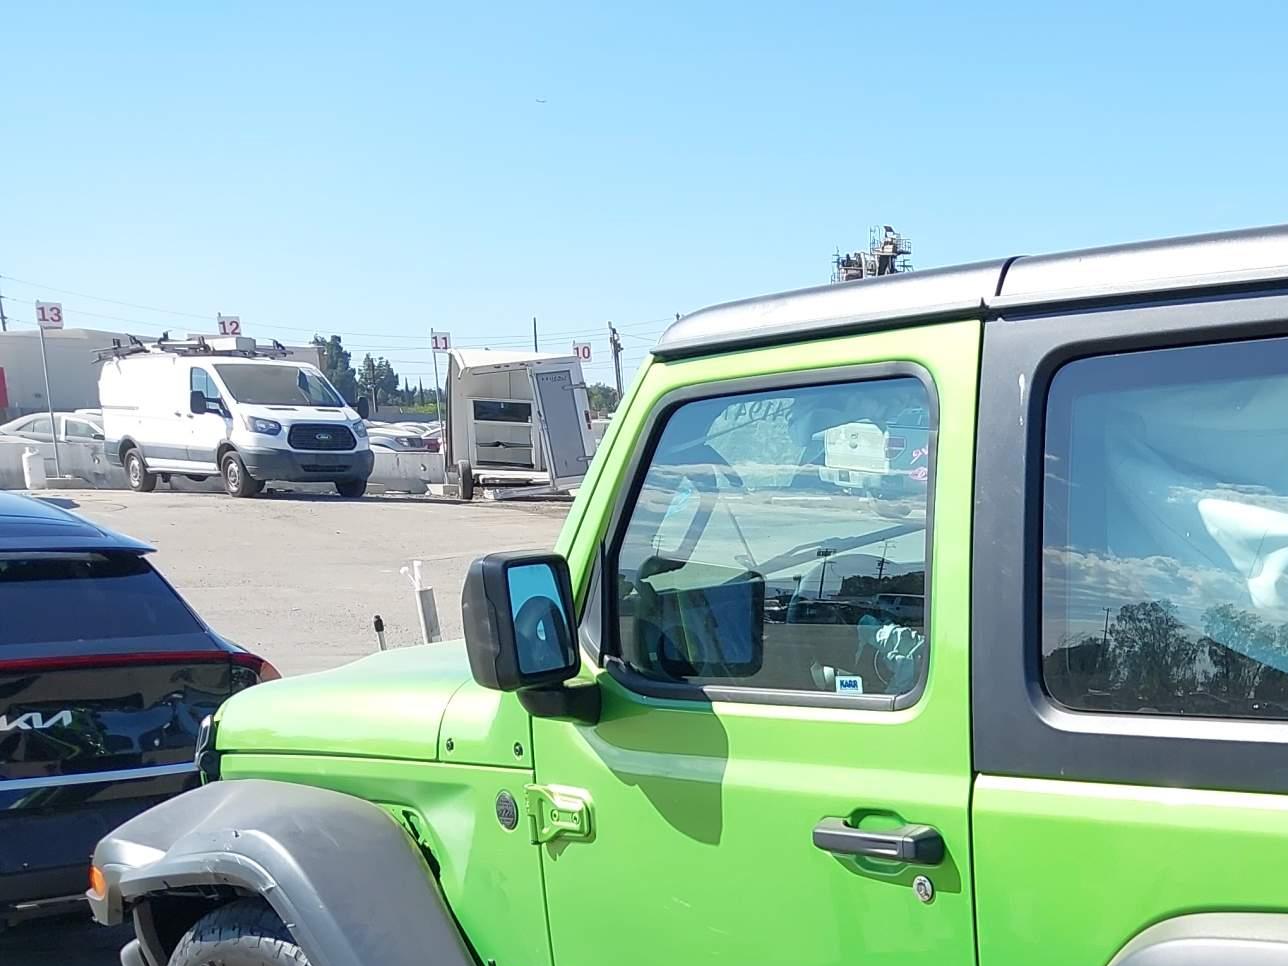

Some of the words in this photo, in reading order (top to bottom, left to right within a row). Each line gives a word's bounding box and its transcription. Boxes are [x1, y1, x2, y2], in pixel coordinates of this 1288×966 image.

[37, 307, 62, 322] 13
[219, 320, 240, 335] 12
[432, 336, 448, 350] 11
[574, 346, 591, 359] 10
[840, 679, 858, 689] KARR
